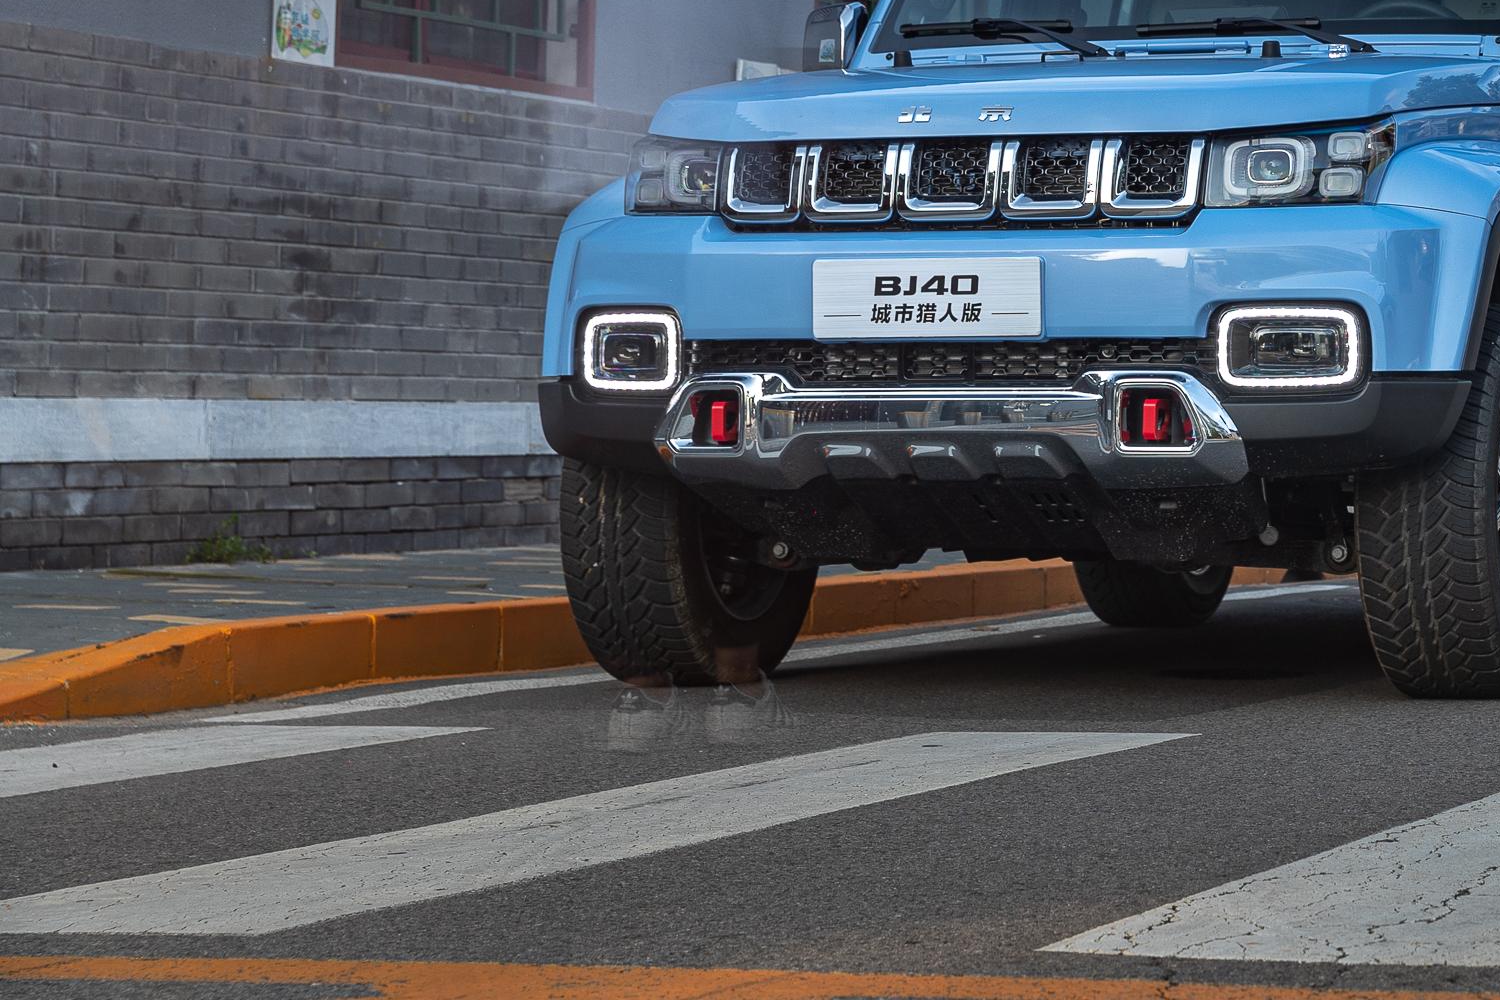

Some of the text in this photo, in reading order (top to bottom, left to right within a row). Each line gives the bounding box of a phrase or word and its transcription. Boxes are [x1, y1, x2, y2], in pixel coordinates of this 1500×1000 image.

[897, 105, 1014, 123] 北京
[874, 275, 979, 296] BJ40
[870, 302, 982, 324] 城市猎人版
